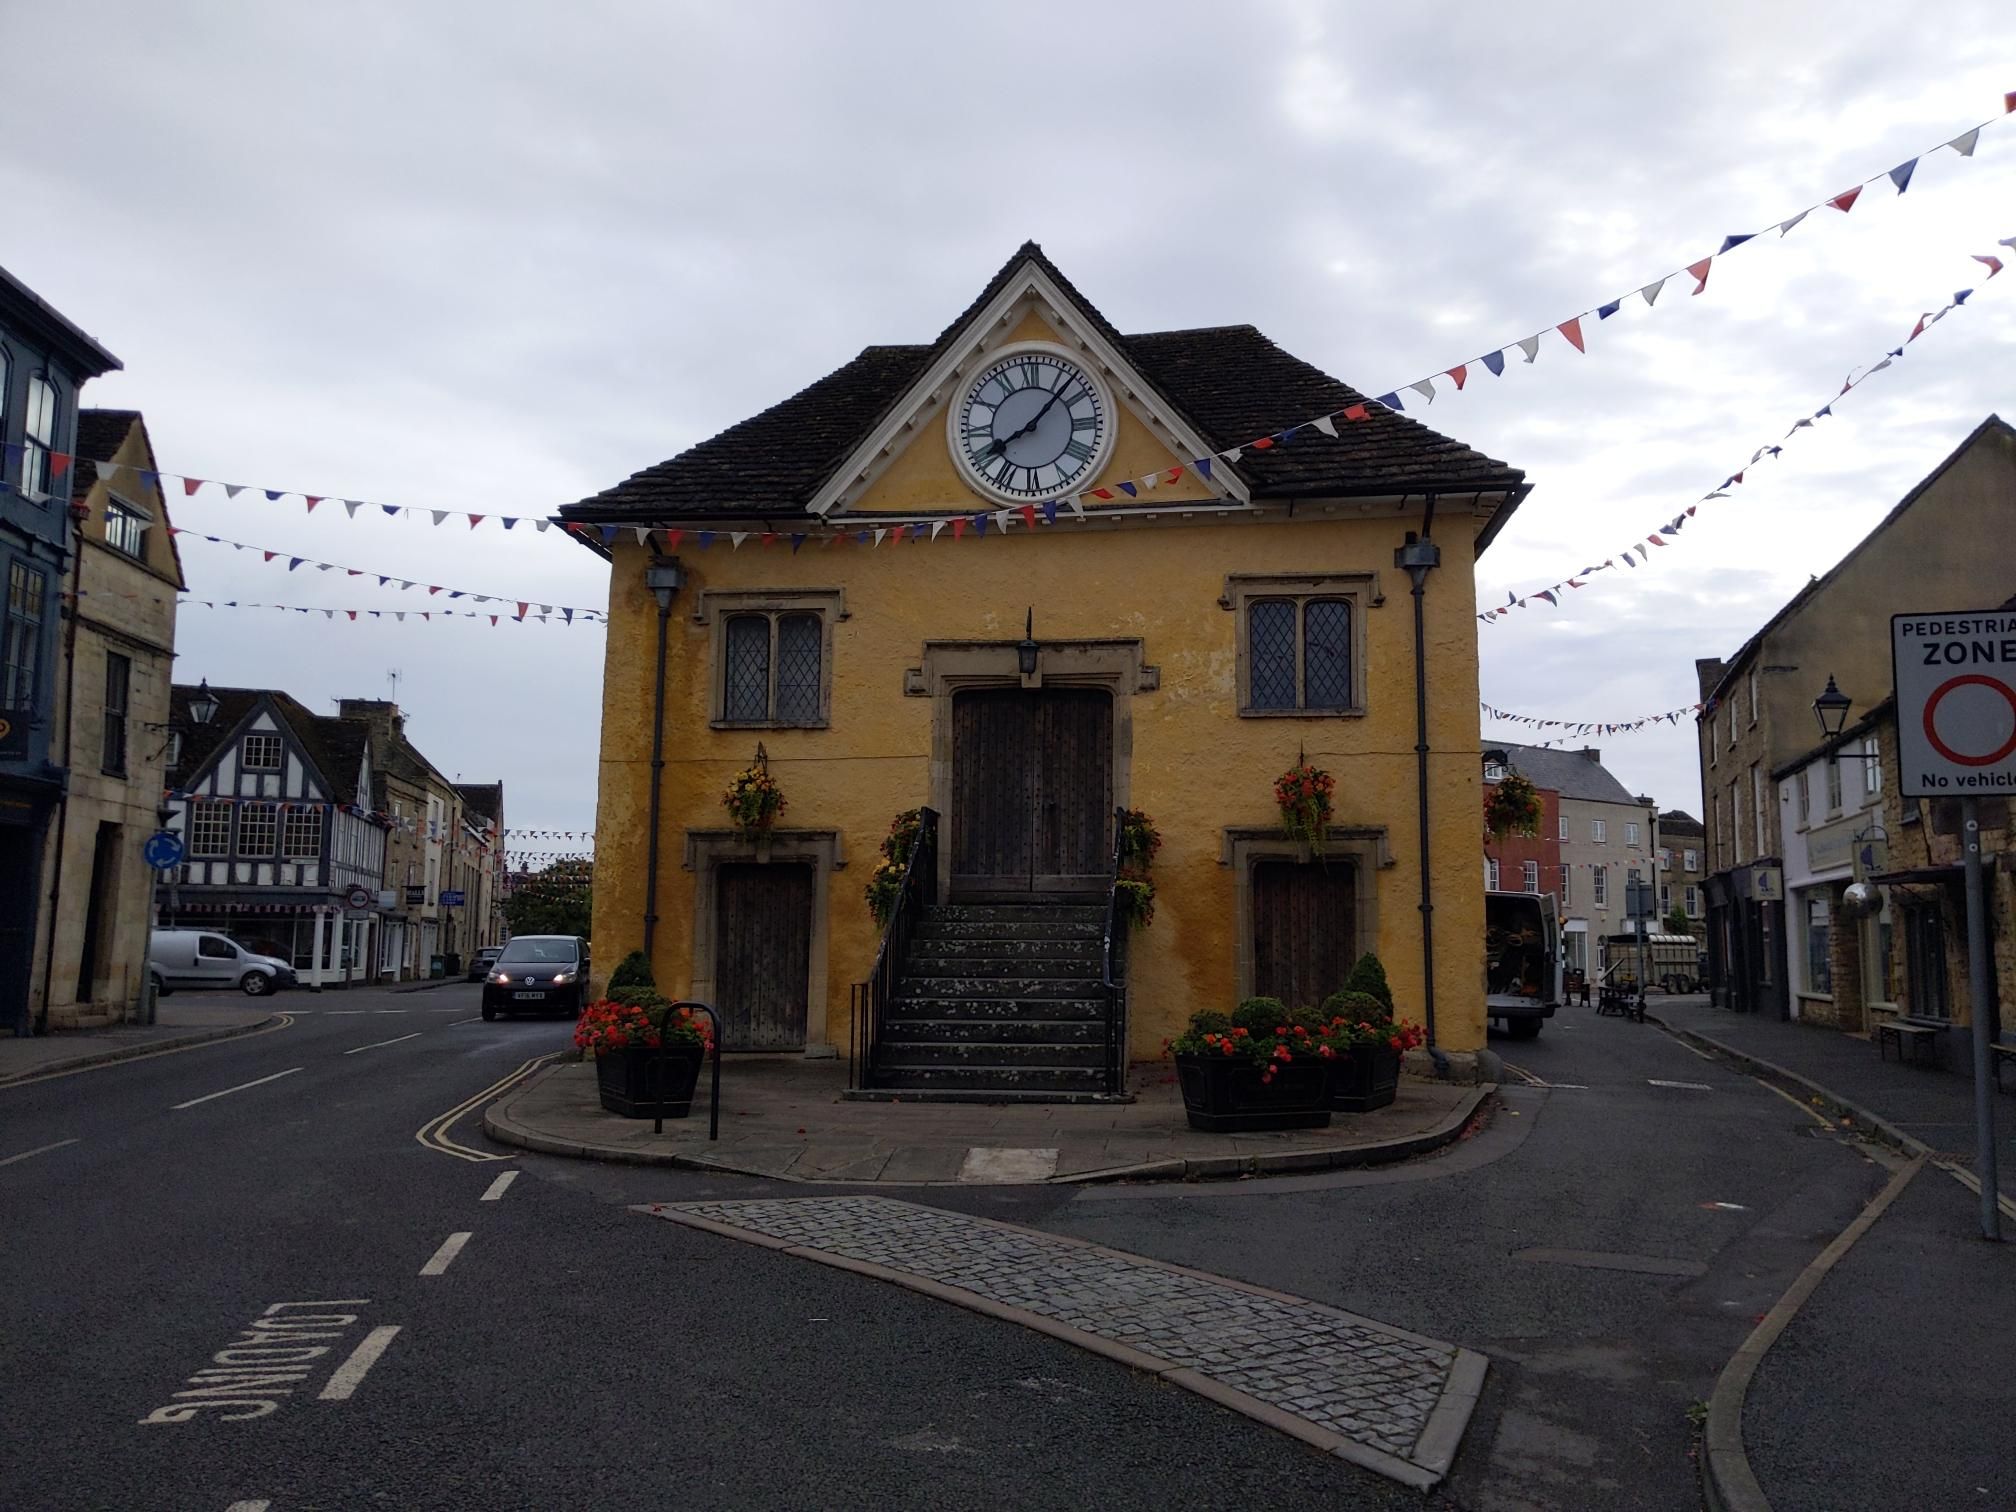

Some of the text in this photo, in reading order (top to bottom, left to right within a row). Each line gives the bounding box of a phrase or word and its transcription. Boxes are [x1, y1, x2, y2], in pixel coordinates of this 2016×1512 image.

[1923, 640, 2016, 665] ZONE
[1921, 772, 2016, 787] No vehicl
[137, 1299, 371, 1425] LOADING
